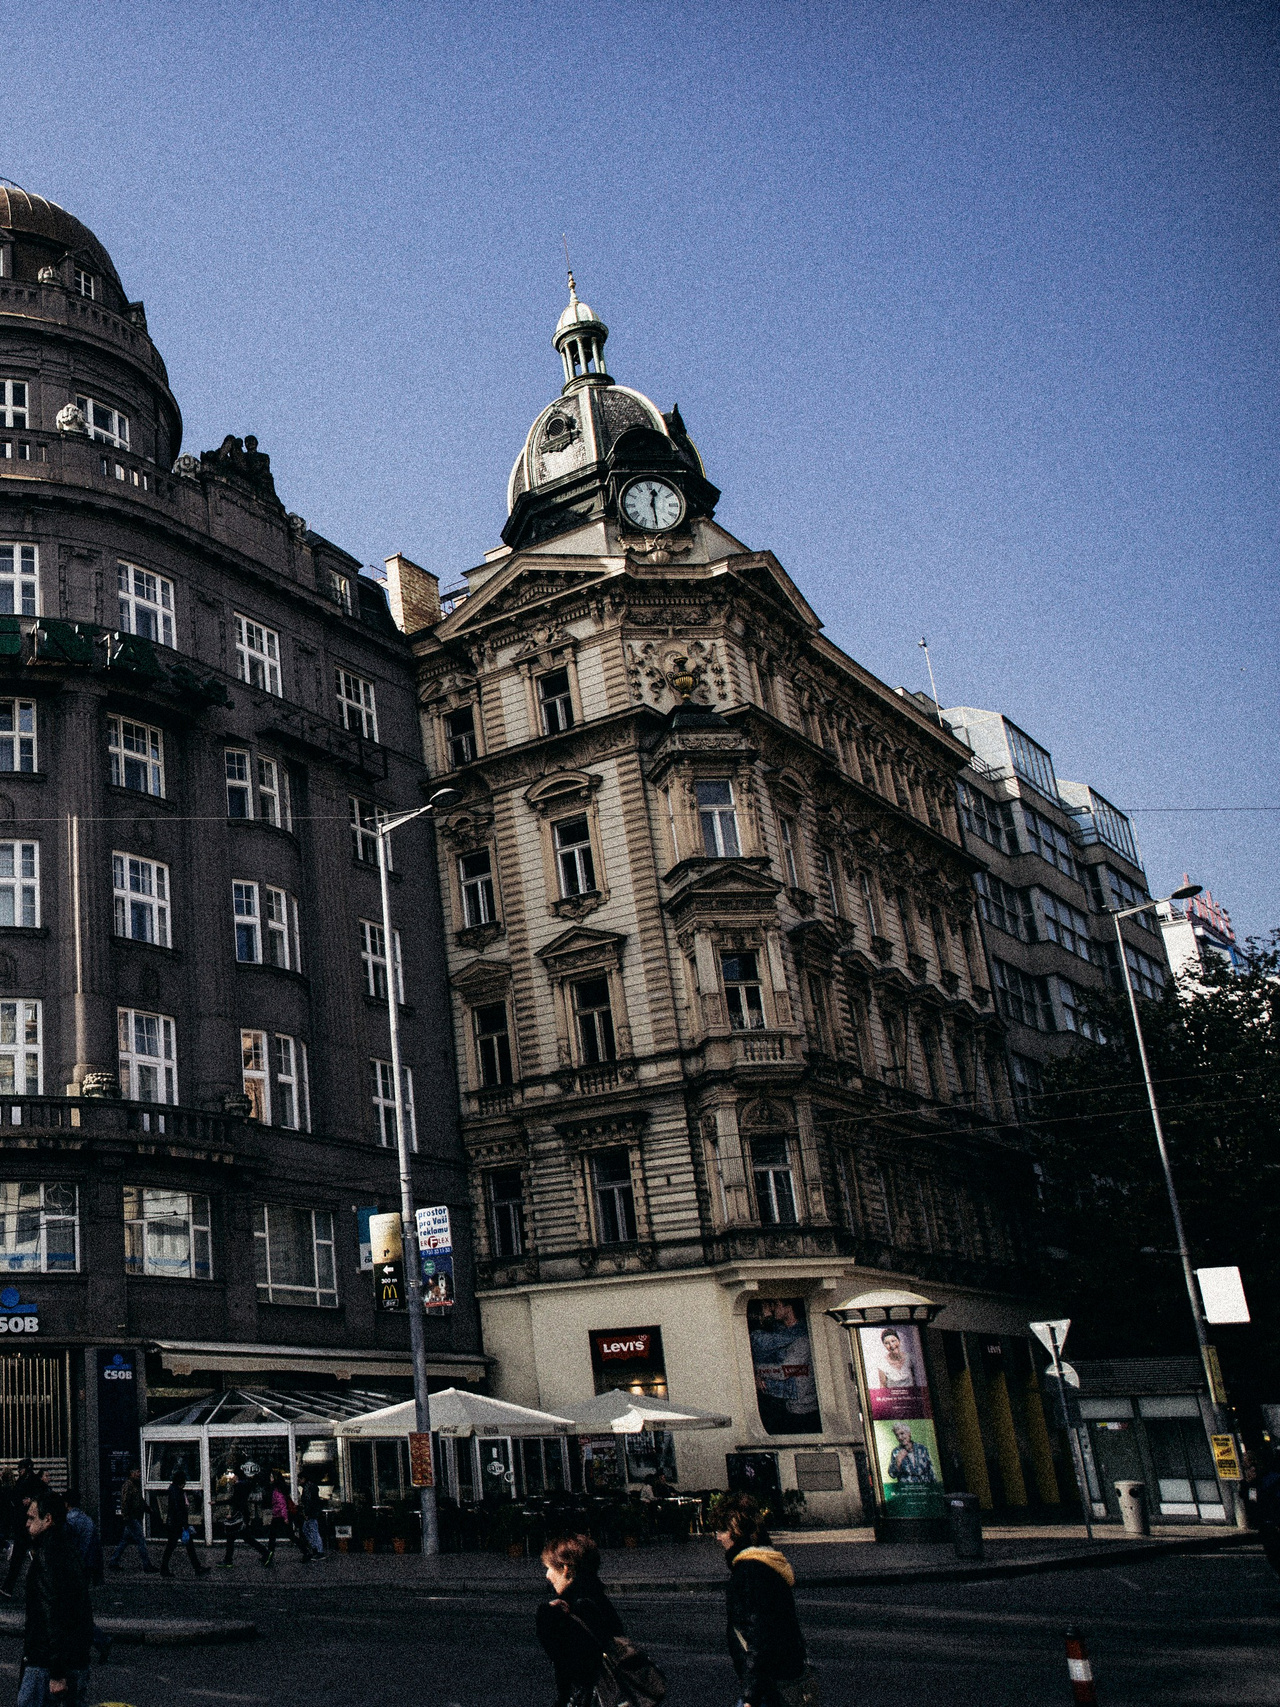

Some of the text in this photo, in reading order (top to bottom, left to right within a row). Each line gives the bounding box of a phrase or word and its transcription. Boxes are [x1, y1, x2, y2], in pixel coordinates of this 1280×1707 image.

[418, 1208, 447, 1220] prostor
[419, 1220, 431, 1229] pro
[420, 1227, 448, 1236] reklamu
[104, 1369, 133, 1380] ČSOB
